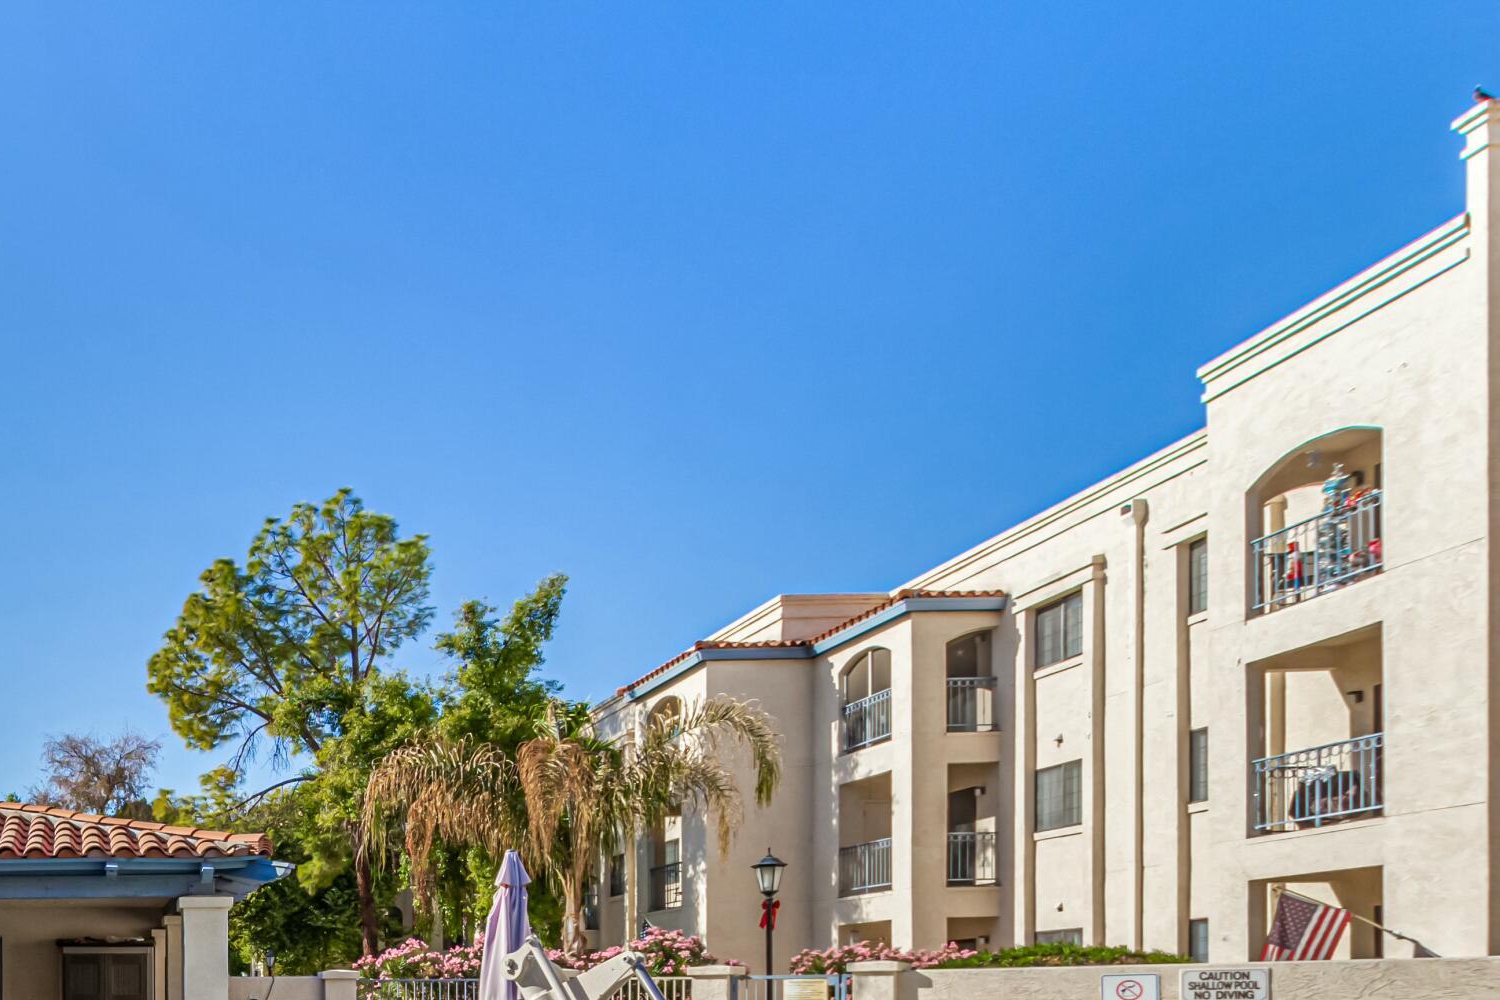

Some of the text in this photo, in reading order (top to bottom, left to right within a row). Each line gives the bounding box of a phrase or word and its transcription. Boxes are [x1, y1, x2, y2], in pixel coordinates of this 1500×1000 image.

[1199, 971, 1250, 981] CAUTION
[1188, 980, 1261, 991] SHALLOW POOL
[1194, 990, 1255, 1000] NO DIVING
